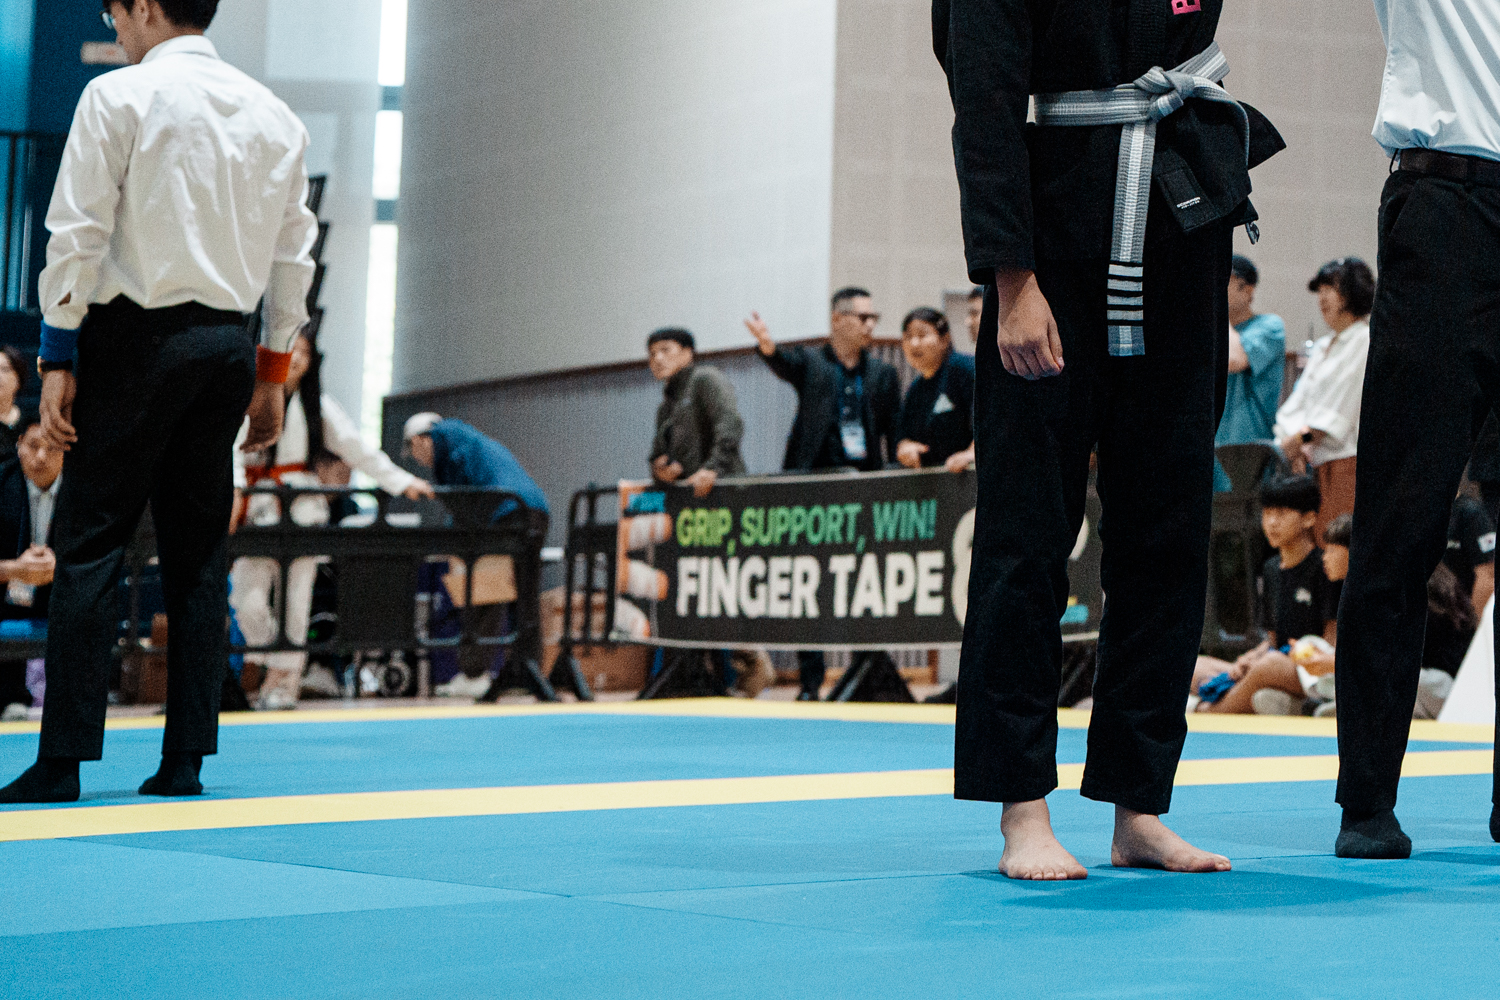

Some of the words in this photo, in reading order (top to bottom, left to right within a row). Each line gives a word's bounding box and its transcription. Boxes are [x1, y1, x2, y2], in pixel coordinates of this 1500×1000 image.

[676, 506, 736, 556] GRIP,
[740, 503, 866, 554] SUPPORT,
[872, 498, 938, 543] WIN!
[675, 554, 821, 619] FINGER
[828, 550, 945, 619] TAPE
